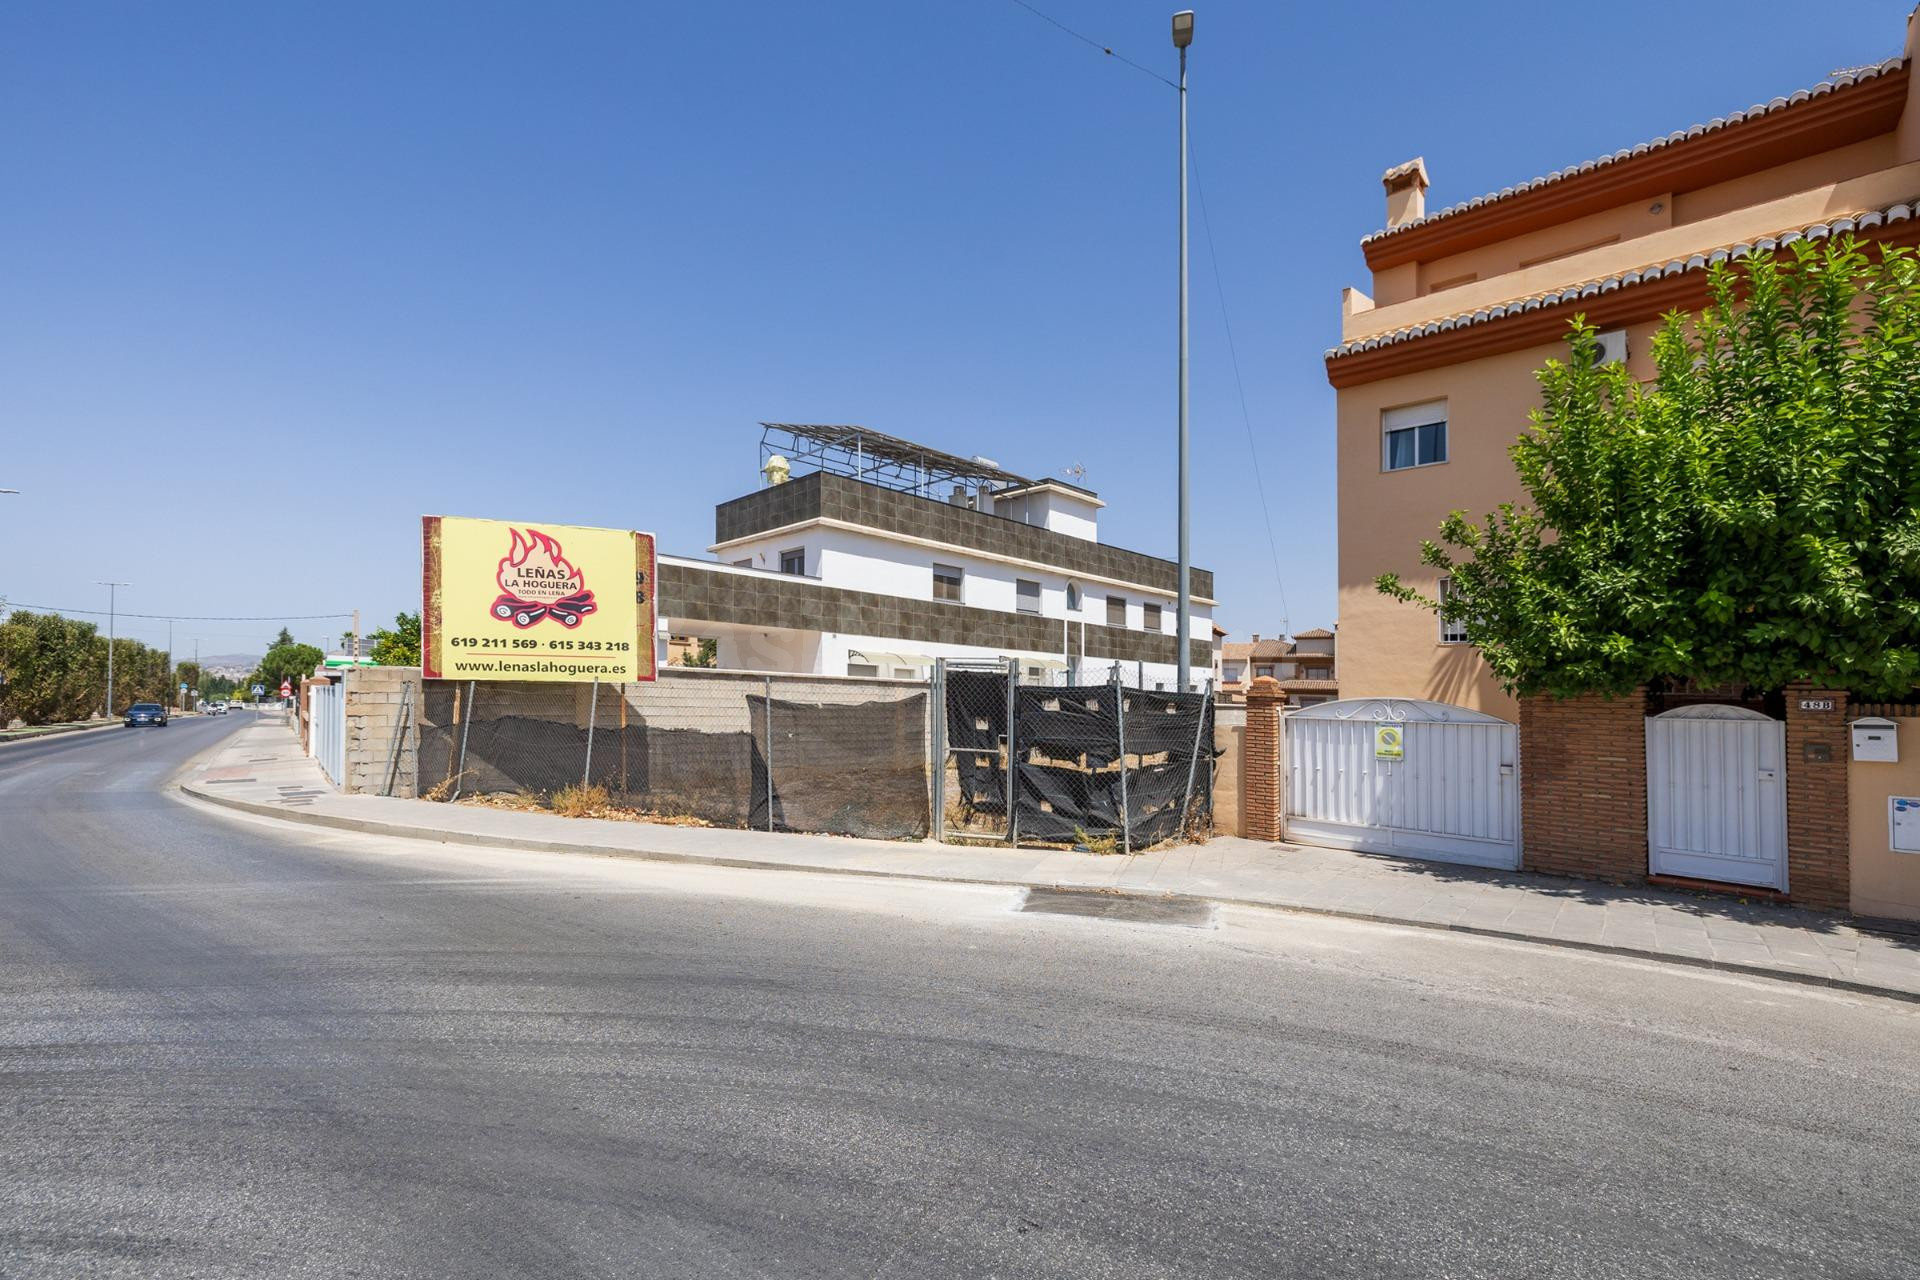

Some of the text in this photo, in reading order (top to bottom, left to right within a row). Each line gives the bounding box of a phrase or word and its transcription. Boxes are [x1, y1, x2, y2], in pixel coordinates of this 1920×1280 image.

[517, 566, 566, 580] LEÑAS
[504, 579, 578, 591] LA HOGUERA
[450, 637, 478, 648] 619
[482, 638, 508, 649] 211
[511, 638, 538, 649] 569
[548, 640, 574, 650] 615
[577, 641, 602, 651] 343
[605, 642, 631, 652] 218
[455, 660, 628, 676] www.lenaslahoguera.es
